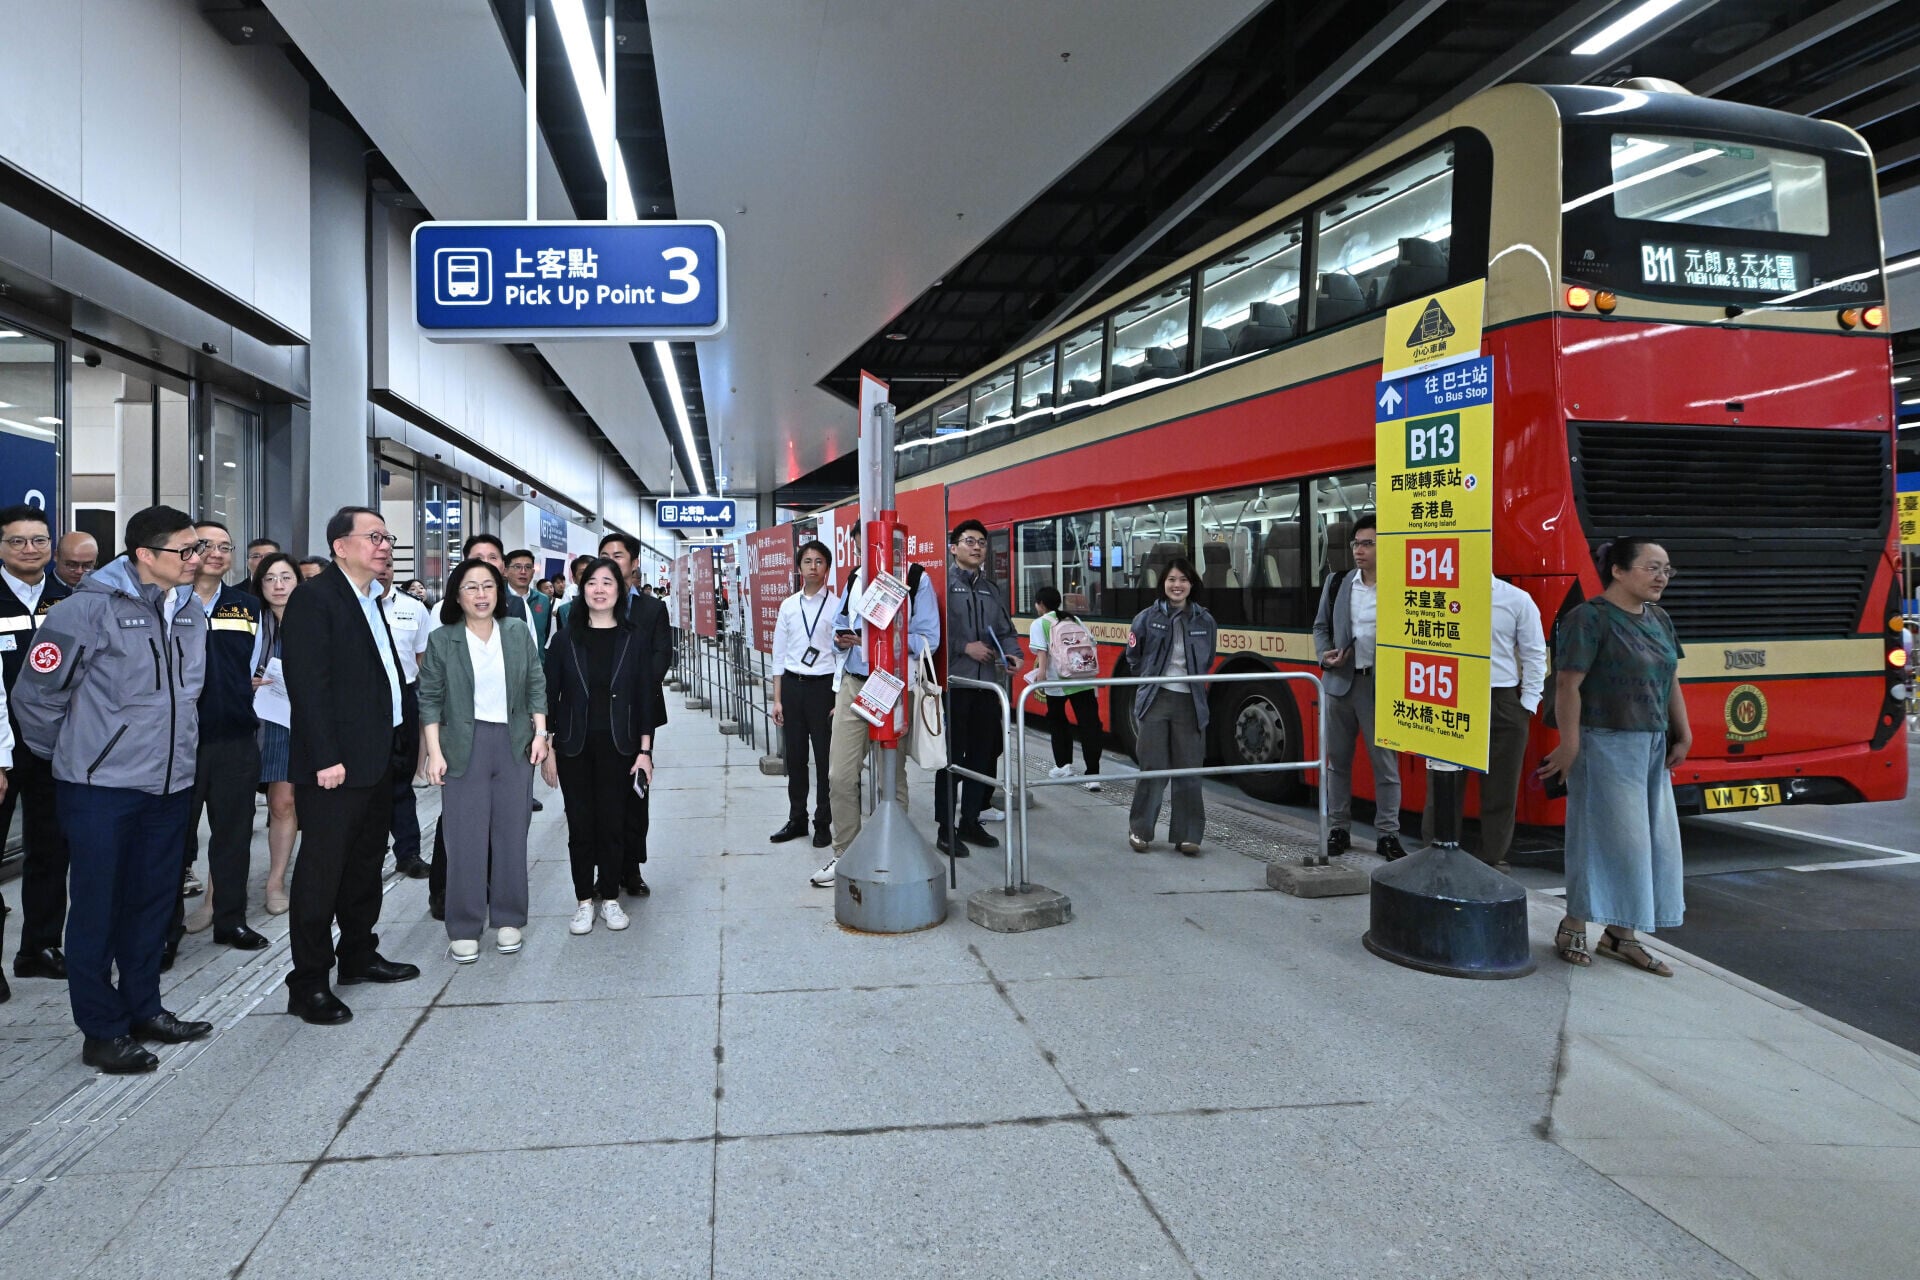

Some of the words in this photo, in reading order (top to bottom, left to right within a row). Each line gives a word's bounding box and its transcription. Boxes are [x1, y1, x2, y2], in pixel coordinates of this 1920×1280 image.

[505, 248, 598, 279] 上客點
[1642, 245, 1676, 283] B11
[661, 247, 701, 305] 3
[1684, 271, 1708, 285] YUEN
[1709, 272, 1731, 287] LONG
[1732, 277, 1740, 288] &
[1741, 275, 1758, 289] TIN
[505, 285, 551, 305] Pick
[558, 285, 590, 310] Up
[597, 285, 655, 305] Point
[1434, 395, 1444, 405] to
[1446, 390, 1463, 403] Bus
[1466, 386, 1488, 401] Stop
[1410, 423, 1455, 461] B13
[1391, 467, 1462, 492] 西隧轉乘站
[719, 505, 732, 522] 4
[1411, 500, 1454, 520] 香港島
[1408, 521, 1423, 529] Hong
[1424, 520, 1438, 528] Kong
[1439, 519, 1457, 527] Island
[1410, 547, 1454, 581] B14
[1404, 590, 1447, 610] 宋皇臺
[1405, 609, 1420, 617] Sung
[1420, 610, 1434, 618] Wong
[1091, 625, 1127, 639] KOWLOON
[1260, 636, 1288, 653] LTD.
[1404, 619, 1461, 640] 九龍市區
[1412, 638, 1427, 646] Urban
[1428, 639, 1453, 648] Kowloon
[1409, 661, 1453, 700] B15
[1393, 700, 1470, 732] 洪水橋、屯門
[1397, 719, 1412, 729] Hung
[1412, 722, 1425, 731] Shui
[1436, 727, 1450, 736] Tuen
[1451, 730, 1465, 740] Mun
[1739, 786, 1774, 804] 7931
